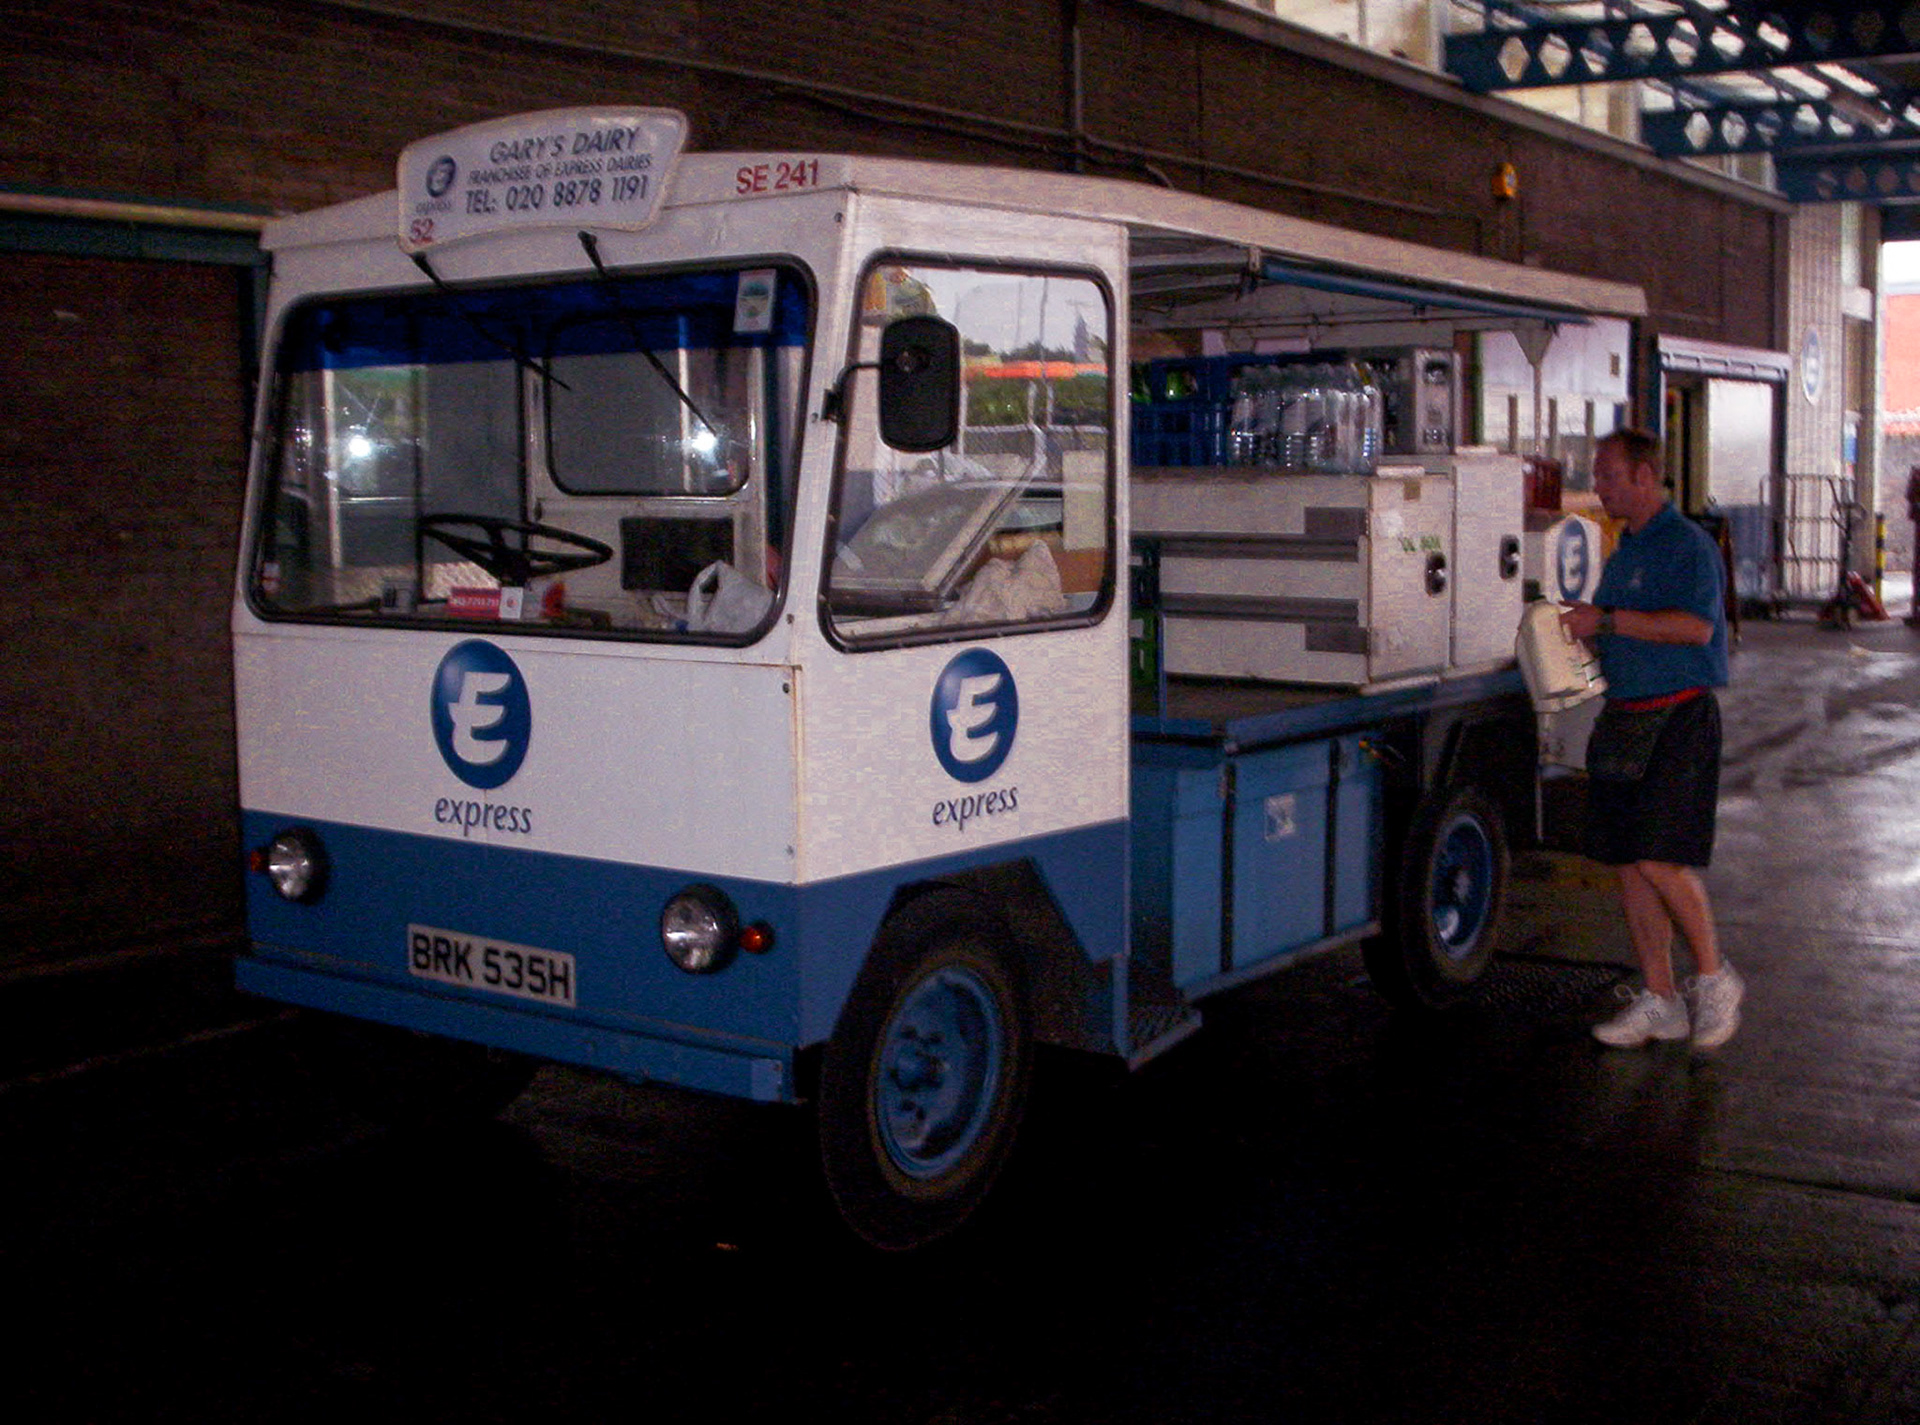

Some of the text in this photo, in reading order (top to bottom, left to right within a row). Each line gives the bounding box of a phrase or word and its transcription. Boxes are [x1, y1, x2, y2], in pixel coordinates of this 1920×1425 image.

[490, 127, 640, 164] GARY'S DAIRY
[606, 153, 653, 172] DAIRIES
[506, 184, 544, 211] 020
[553, 178, 602, 207] 8878
[611, 174, 649, 201] 1191
[736, 158, 819, 195] SE 241
[434, 796, 533, 835] express
[931, 785, 1019, 831] express
[412, 932, 570, 999] BRK 535H
